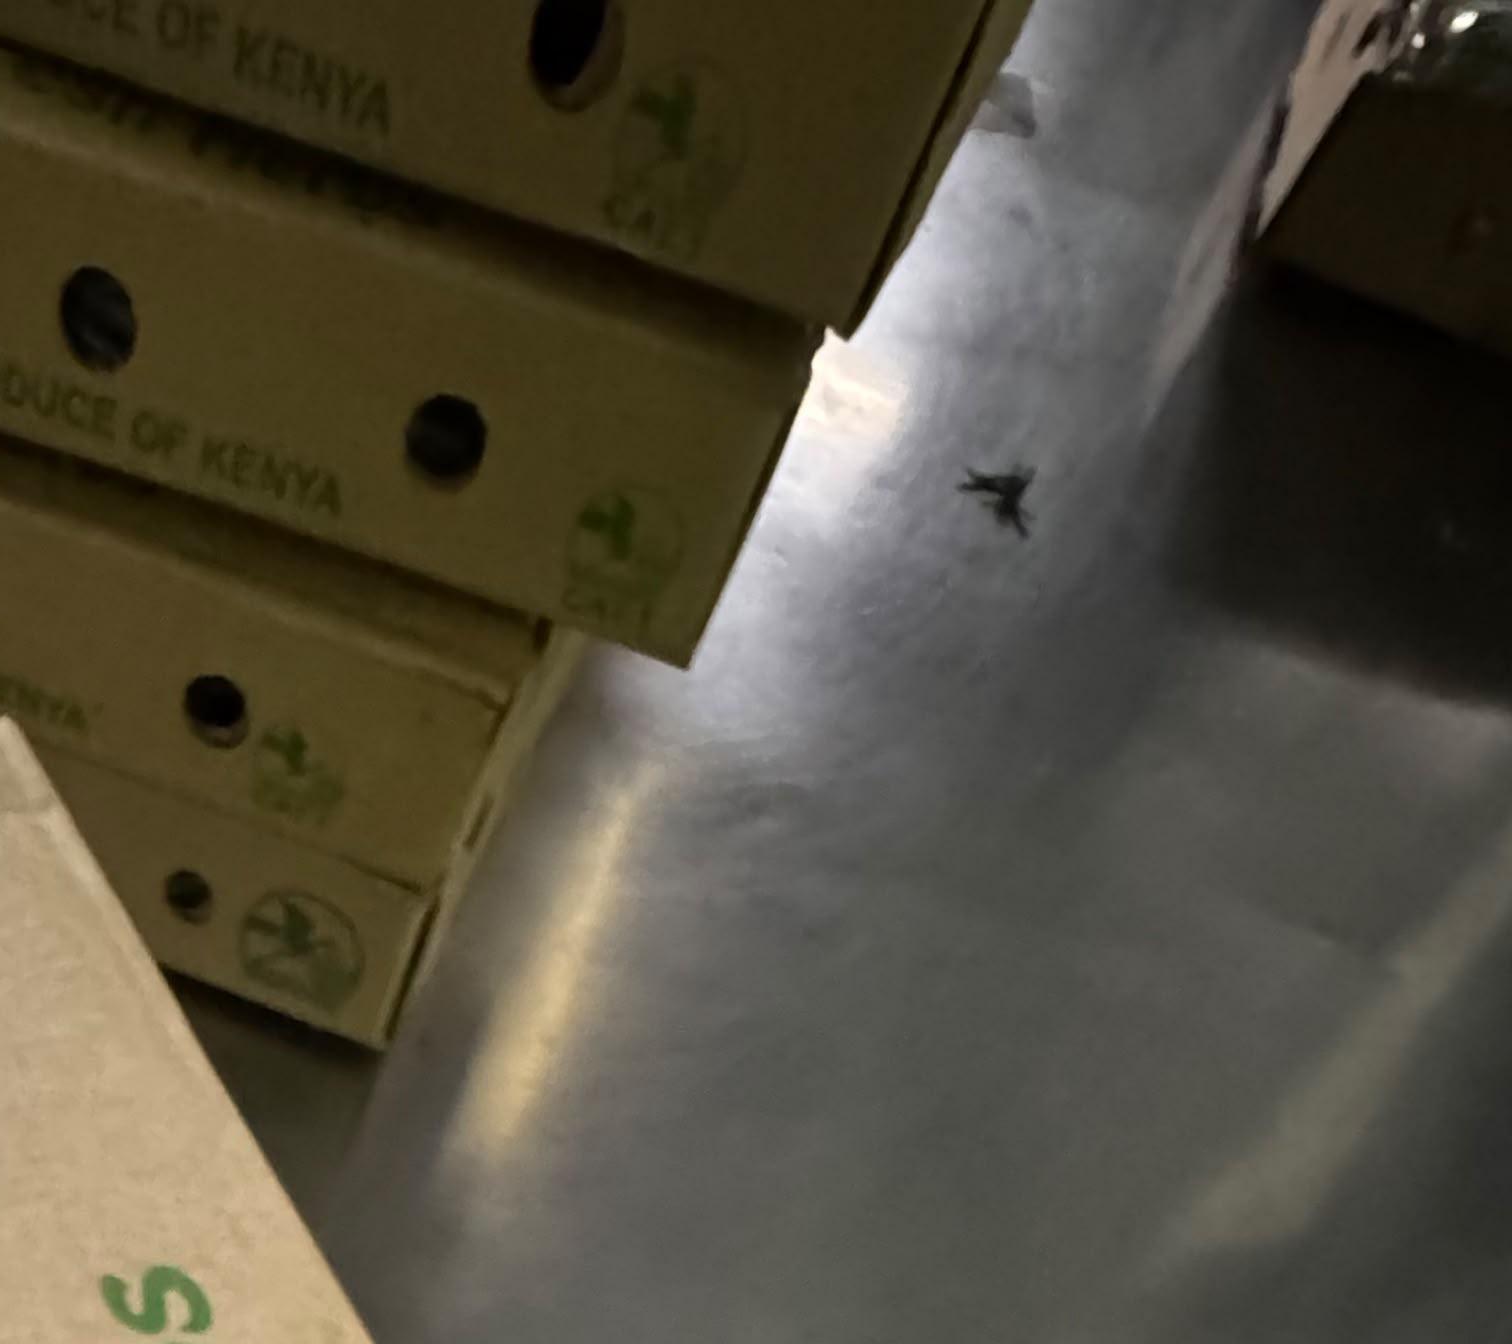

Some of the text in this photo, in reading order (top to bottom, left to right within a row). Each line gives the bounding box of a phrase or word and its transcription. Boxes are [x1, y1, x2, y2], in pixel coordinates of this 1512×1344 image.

[233, 24, 392, 137] KENYA
[129, 408, 190, 457] OF
[200, 436, 344, 517] KENYA
